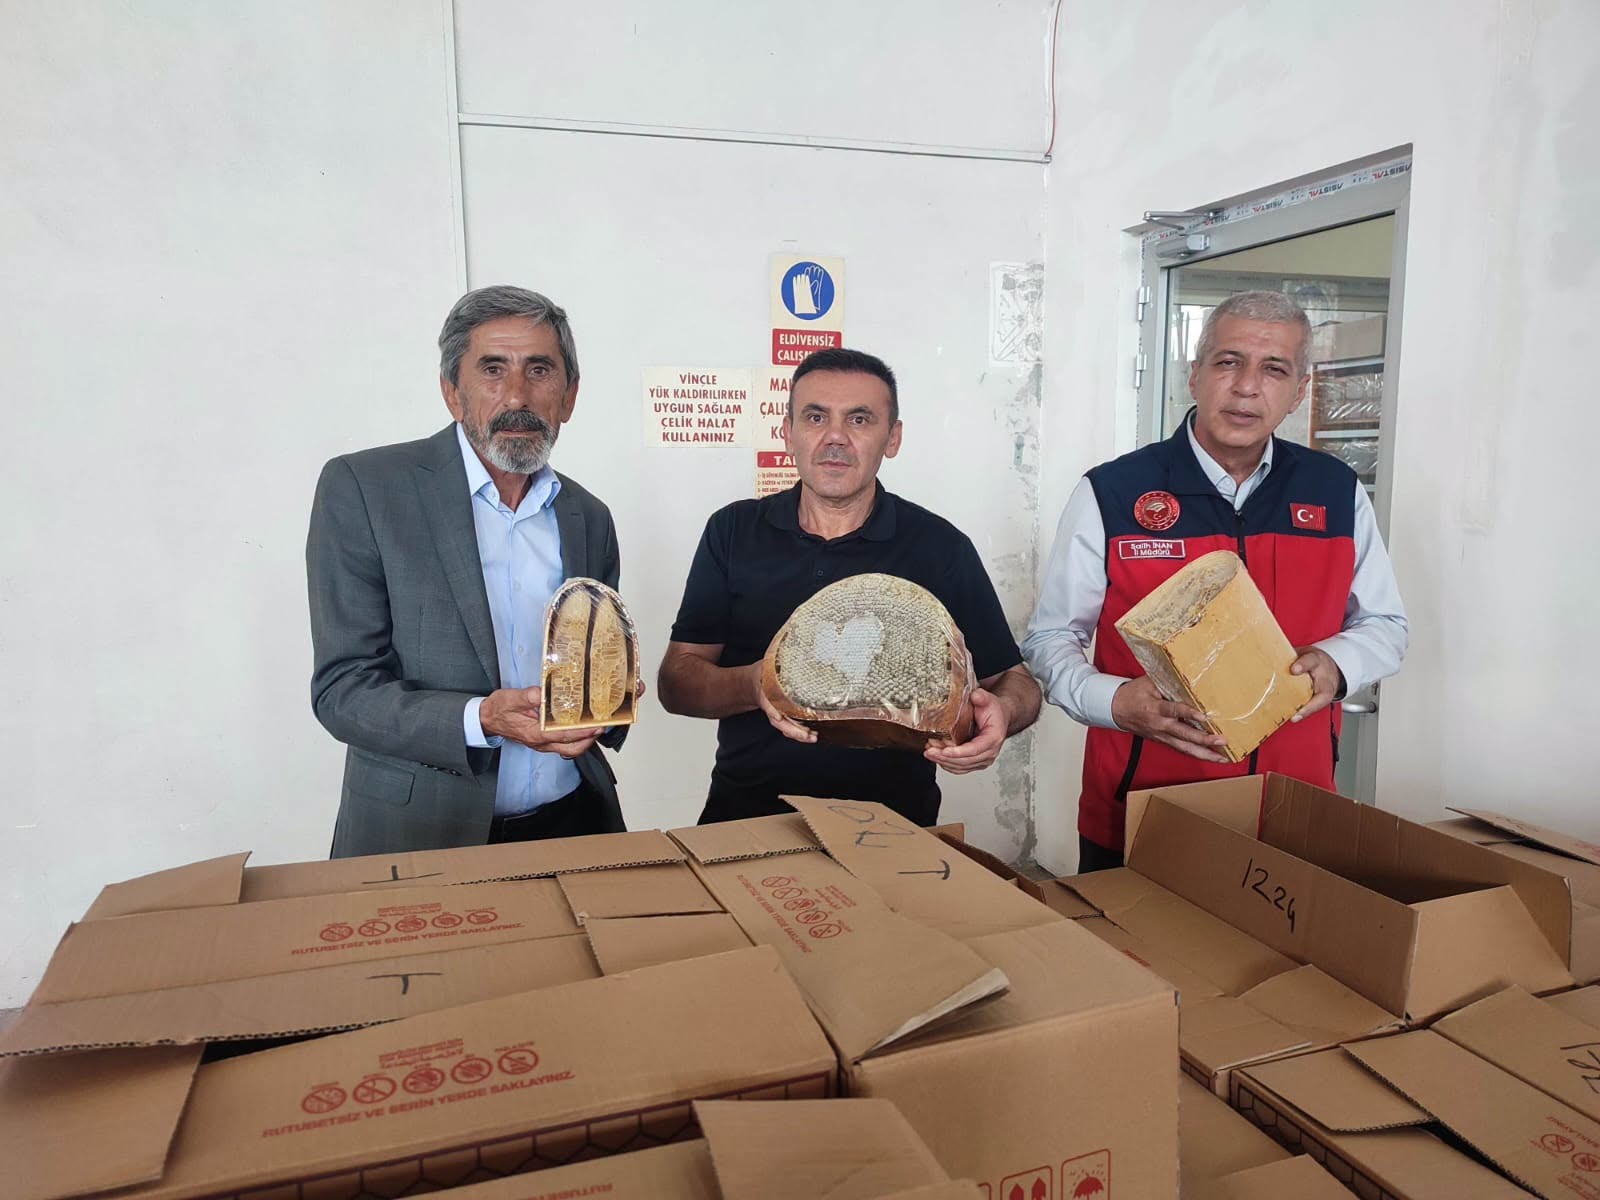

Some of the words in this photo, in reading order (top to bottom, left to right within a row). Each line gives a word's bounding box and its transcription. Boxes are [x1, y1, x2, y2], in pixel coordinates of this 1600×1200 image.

[1309, 183, 1344, 198] ASISTAL
[779, 333, 835, 347] ELDİVENSİZ
[649, 385, 670, 399] YÜK
[673, 388, 747, 400] KALDIRILIRKEN
[654, 402, 693, 413] UYGUN
[697, 401, 742, 414] SAĞLAM
[661, 415, 693, 430] ÇELİK
[697, 418, 736, 429] HALAT
[662, 431, 735, 443] KULLANINIZ
[1241, 857, 1295, 934] 1224
[365, 1107, 385, 1119] VE
[438, 1087, 488, 1105] YERDE
